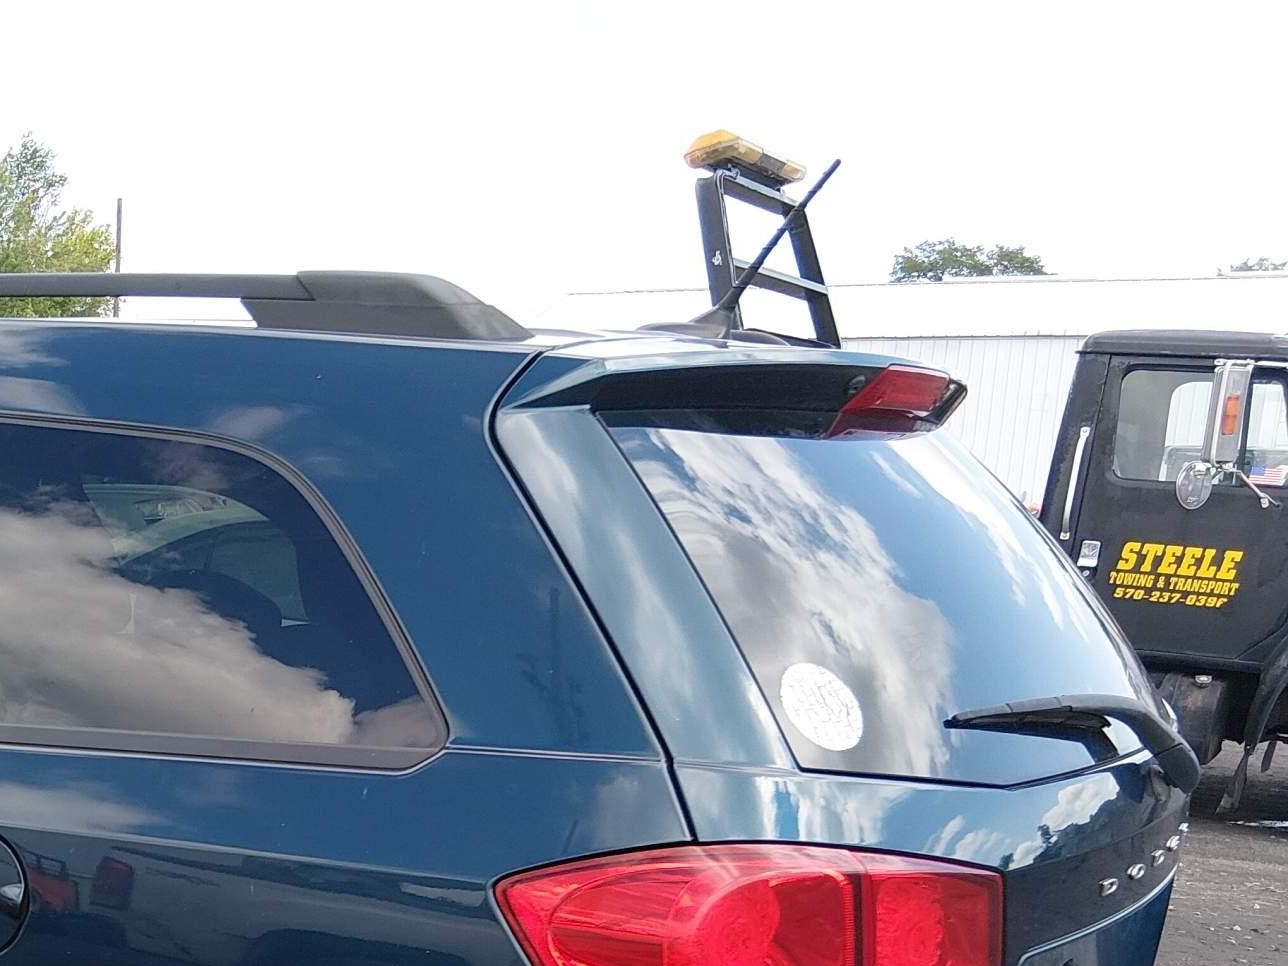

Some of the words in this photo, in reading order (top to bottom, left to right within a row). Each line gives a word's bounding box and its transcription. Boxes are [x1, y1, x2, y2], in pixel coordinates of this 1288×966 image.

[1117, 541, 1243, 580] STEELE
[1109, 571, 1155, 589] TOWING
[1156, 576, 1165, 588] &
[1169, 577, 1240, 597] TRANSPORT
[1098, 822, 1190, 897] DODGE
